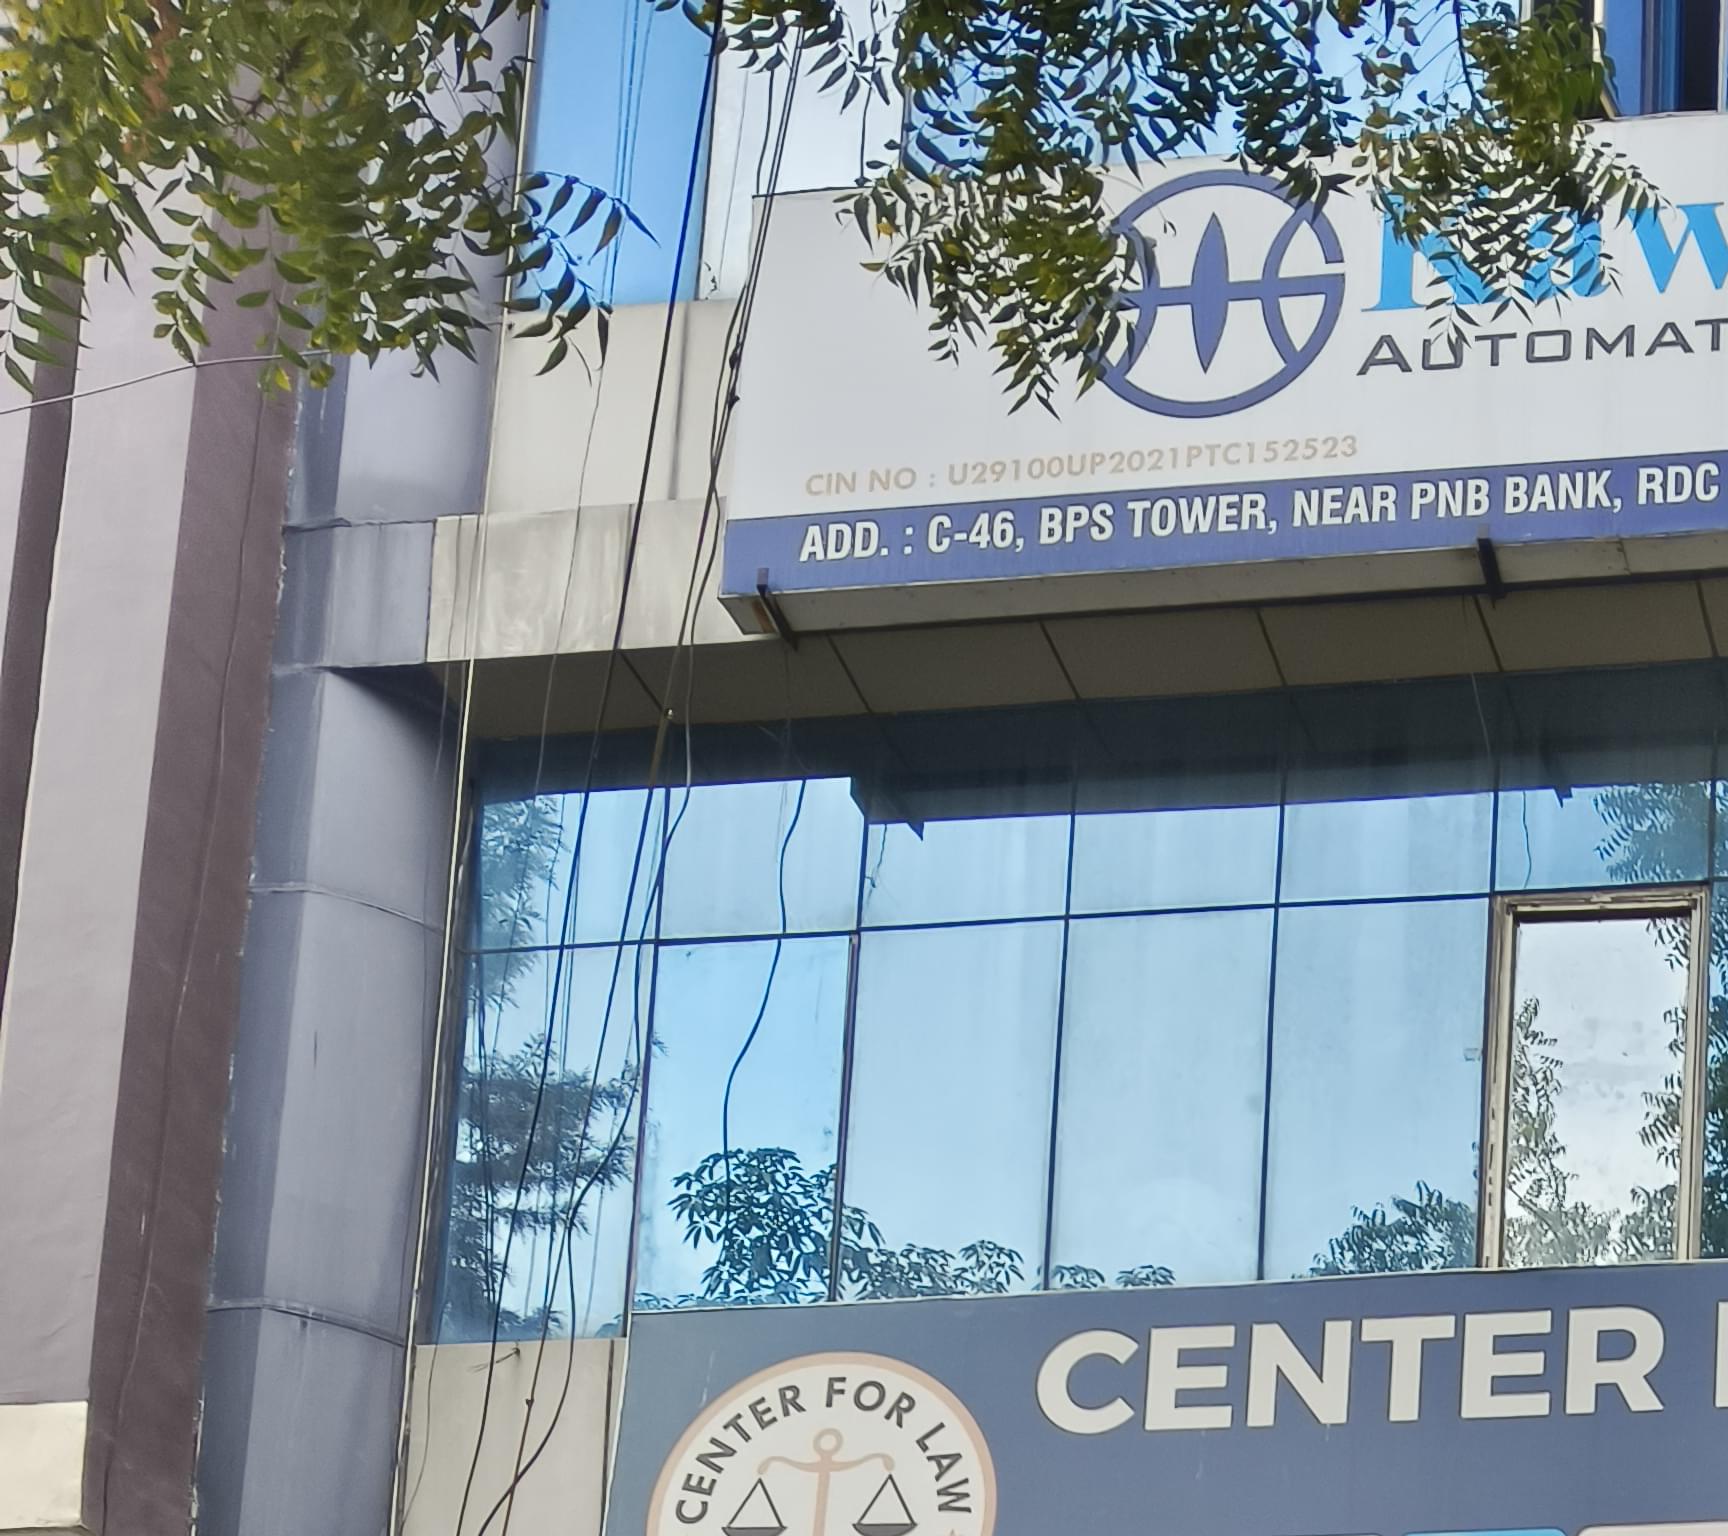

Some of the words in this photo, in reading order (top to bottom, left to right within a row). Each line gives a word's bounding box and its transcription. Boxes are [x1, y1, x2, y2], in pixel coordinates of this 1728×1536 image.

[799, 519, 888, 563] ADD.
[926, 510, 1024, 553] C-46,
[1038, 502, 1116, 546] BPS
[1126, 492, 1278, 537] TOWER,
[1291, 484, 1398, 528] NEAR
[1409, 478, 1490, 521] PNB
[1503, 470, 1622, 515] BANK,
[1636, 462, 1719, 505] RDC
[804, 471, 857, 497] CIN
[868, 466, 917, 493] NO
[947, 435, 1358, 488] U29100UP2021PTC152523
[1036, 1306, 1665, 1435] CENTER
[675, 1383, 807, 1525] CENTER
[825, 1376, 917, 1429] FOR
[915, 1421, 972, 1514] LAW
